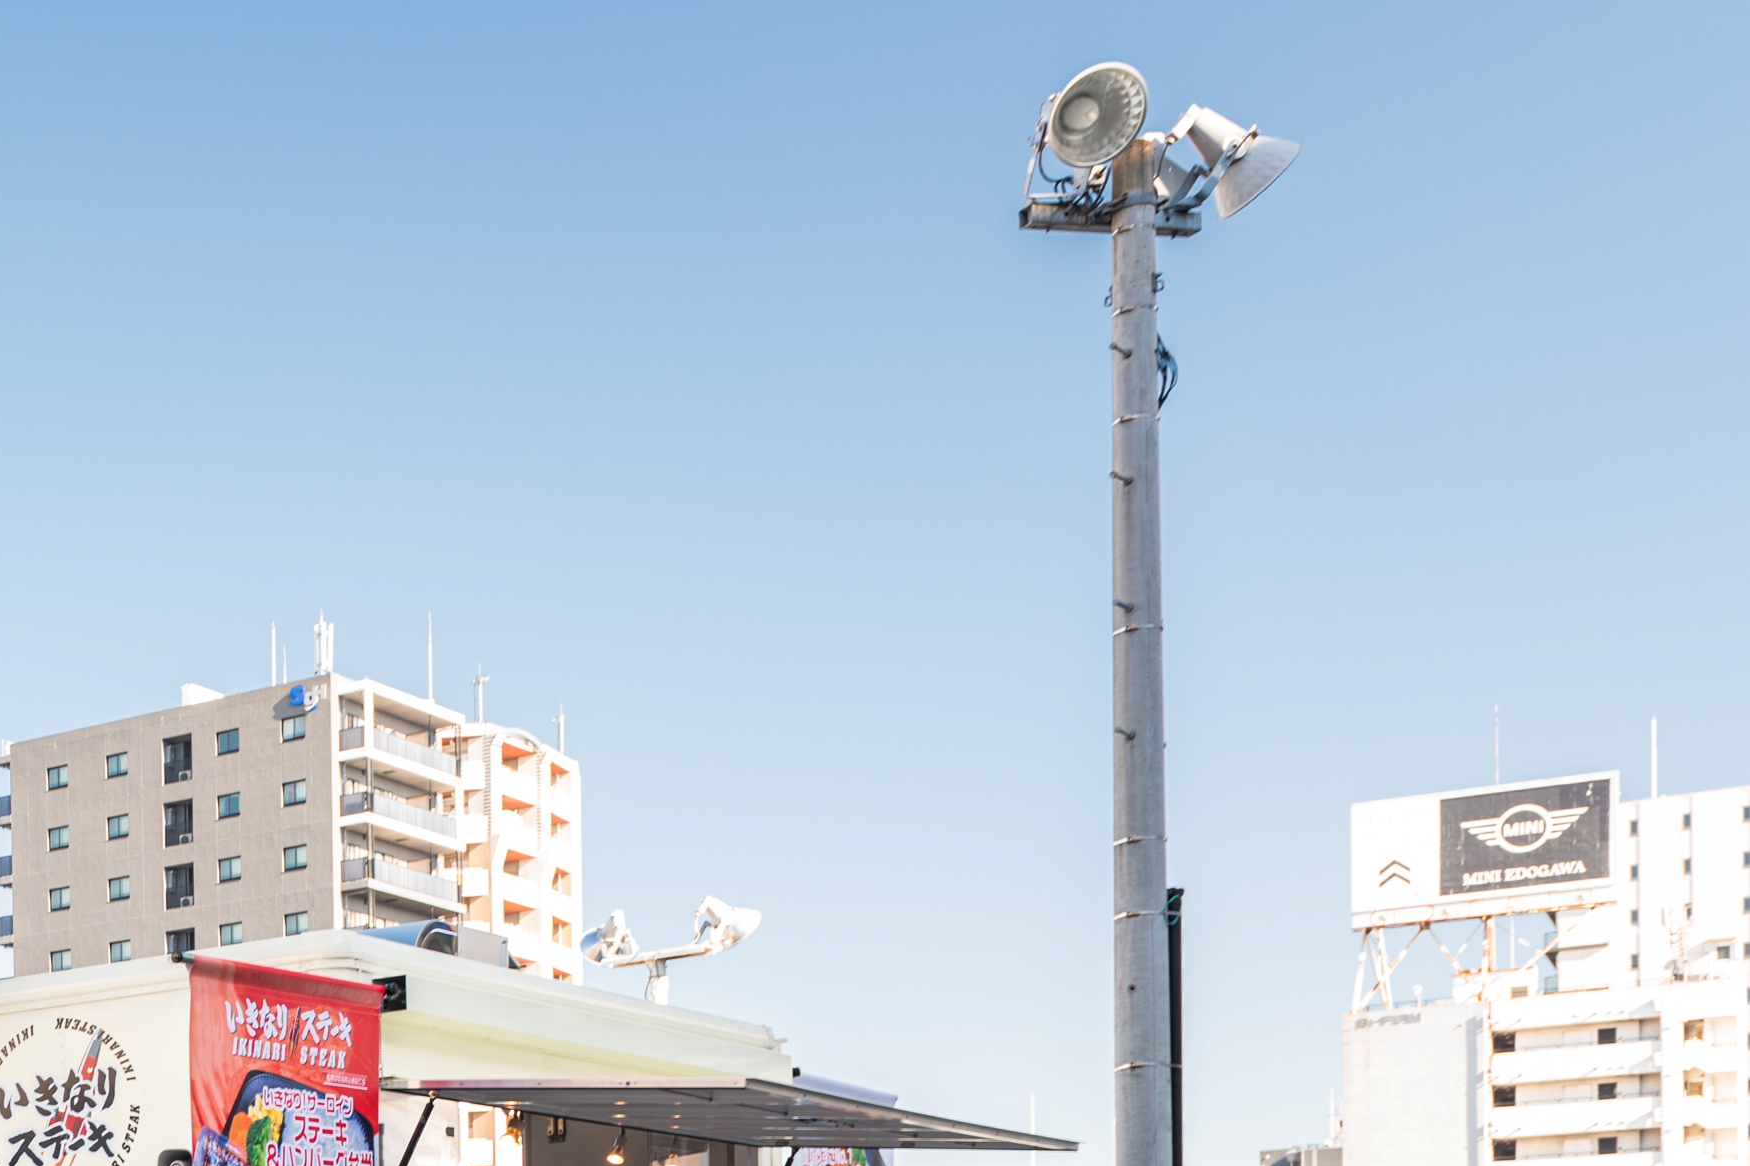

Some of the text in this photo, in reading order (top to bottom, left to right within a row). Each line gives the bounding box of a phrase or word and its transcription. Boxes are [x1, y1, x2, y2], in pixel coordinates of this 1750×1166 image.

[1503, 819, 1545, 838] MINI
[1462, 860, 1586, 886] MINI EDOGAWA
[224, 997, 353, 1048] いきなり ステーキ
[231, 1036, 347, 1070] IKINARI STEAK
[121, 1103, 141, 1154] STEAK
[294, 1115, 348, 1147] ステーキ
